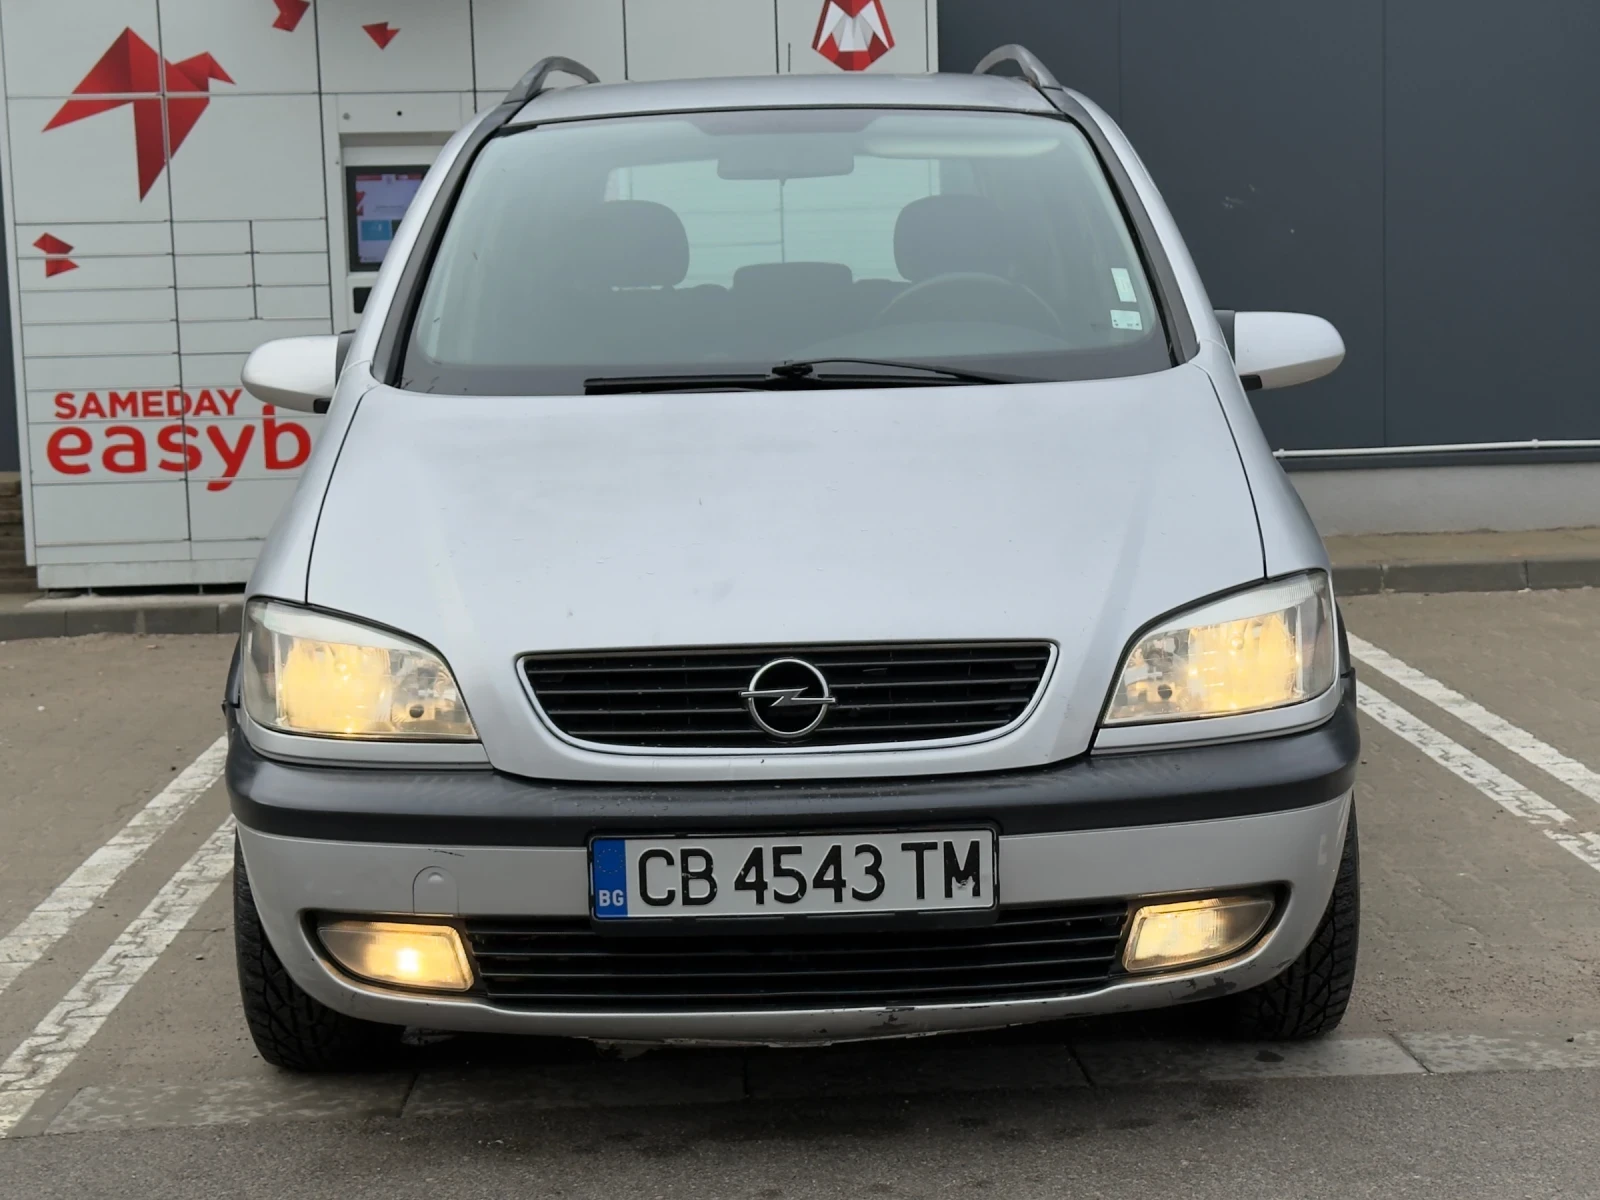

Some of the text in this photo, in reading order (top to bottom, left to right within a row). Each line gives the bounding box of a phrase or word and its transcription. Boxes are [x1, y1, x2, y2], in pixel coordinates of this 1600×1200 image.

[54, 388, 243, 420] SAMEDAY
[637, 840, 982, 907] CB 4543 TM
[598, 889, 625, 908] BG
